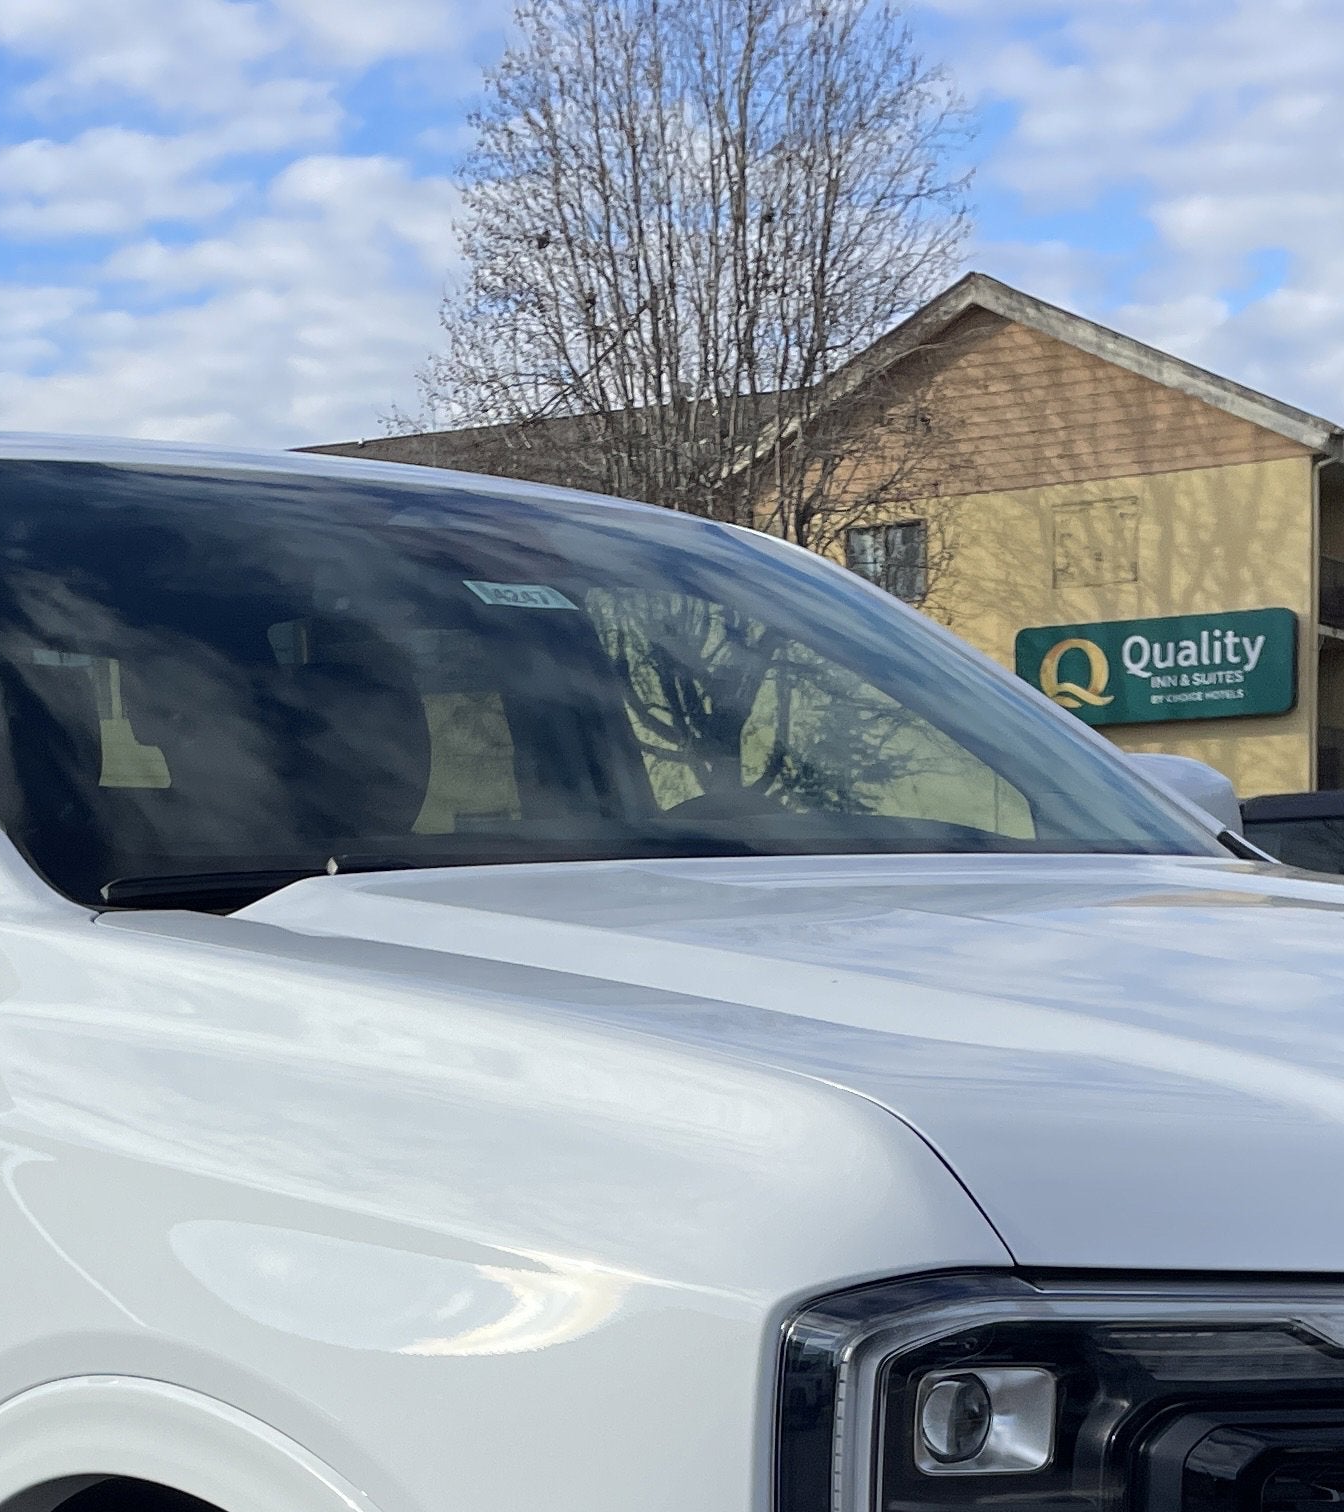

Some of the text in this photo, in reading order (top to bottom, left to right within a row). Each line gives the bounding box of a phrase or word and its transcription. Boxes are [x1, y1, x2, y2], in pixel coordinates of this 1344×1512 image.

[1121, 629, 1266, 678] Quality
[1150, 669, 1244, 688] INN & SUITES
[1204, 688, 1244, 699] HOTELS
